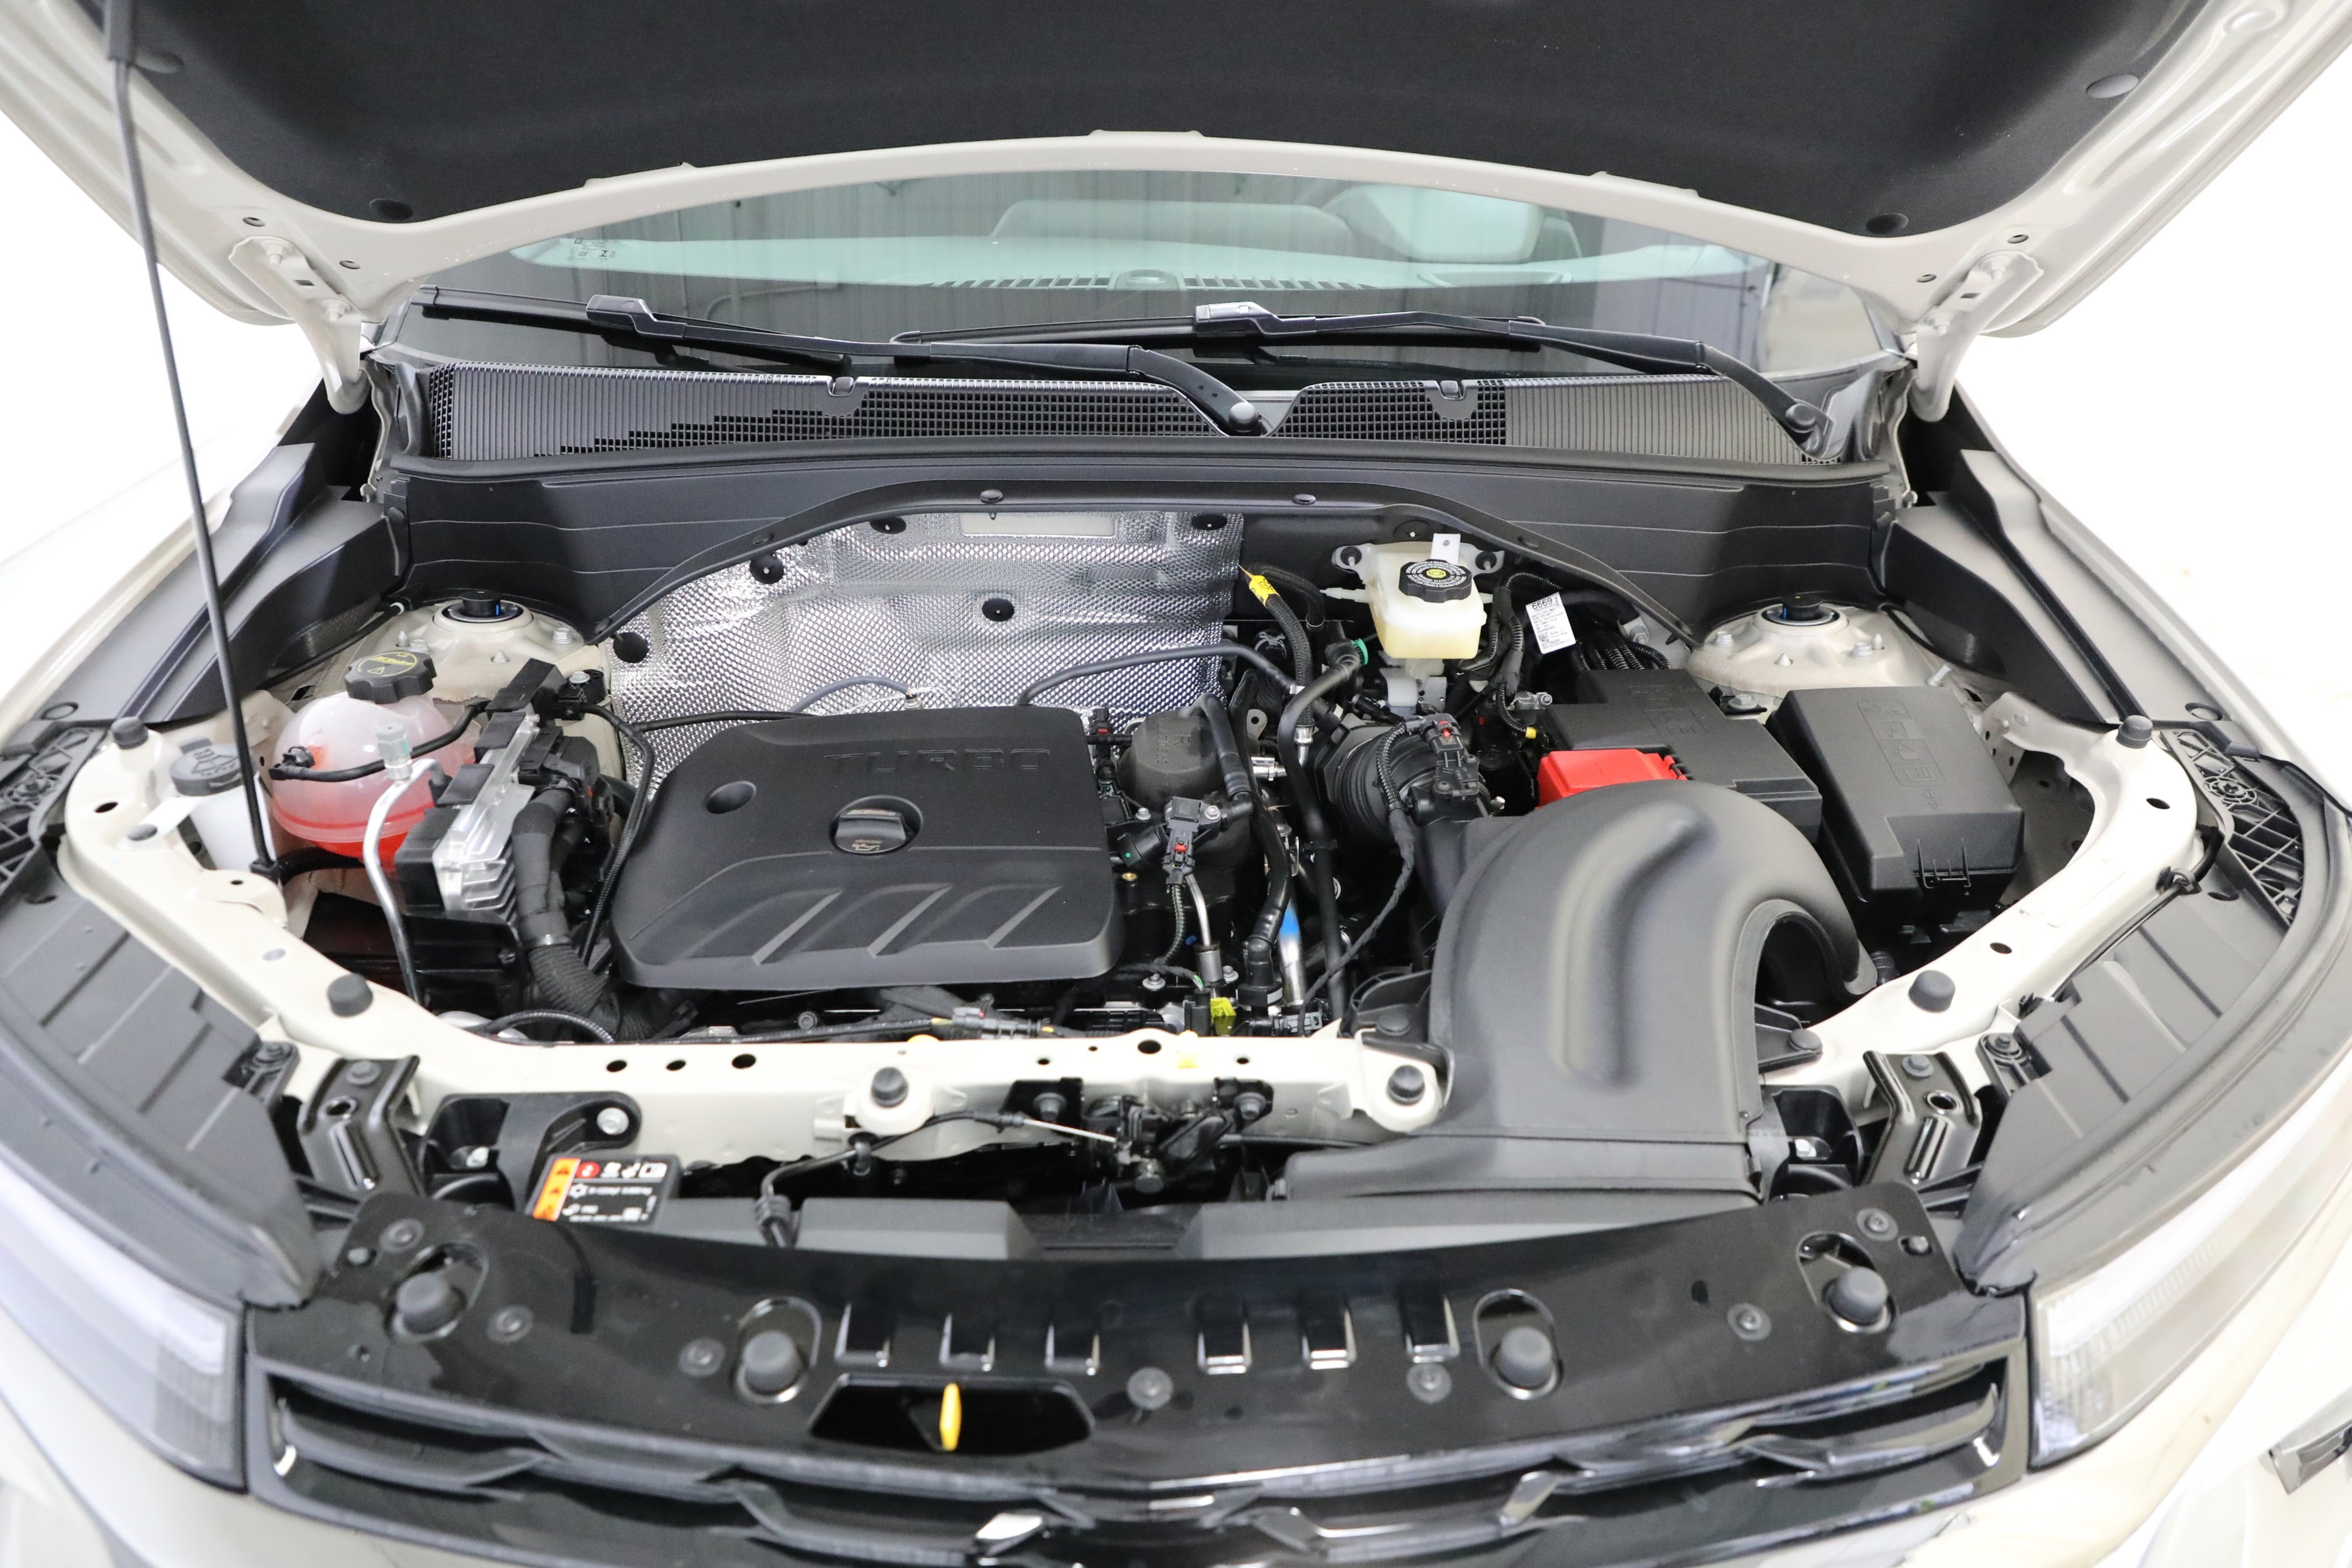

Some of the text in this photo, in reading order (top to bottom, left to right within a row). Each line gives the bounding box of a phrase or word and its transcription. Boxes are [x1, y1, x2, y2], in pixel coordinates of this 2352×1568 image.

[1532, 597, 1553, 610] 6669
[1173, 734, 1191, 746] R
[824, 748, 1051, 773] TURBO
